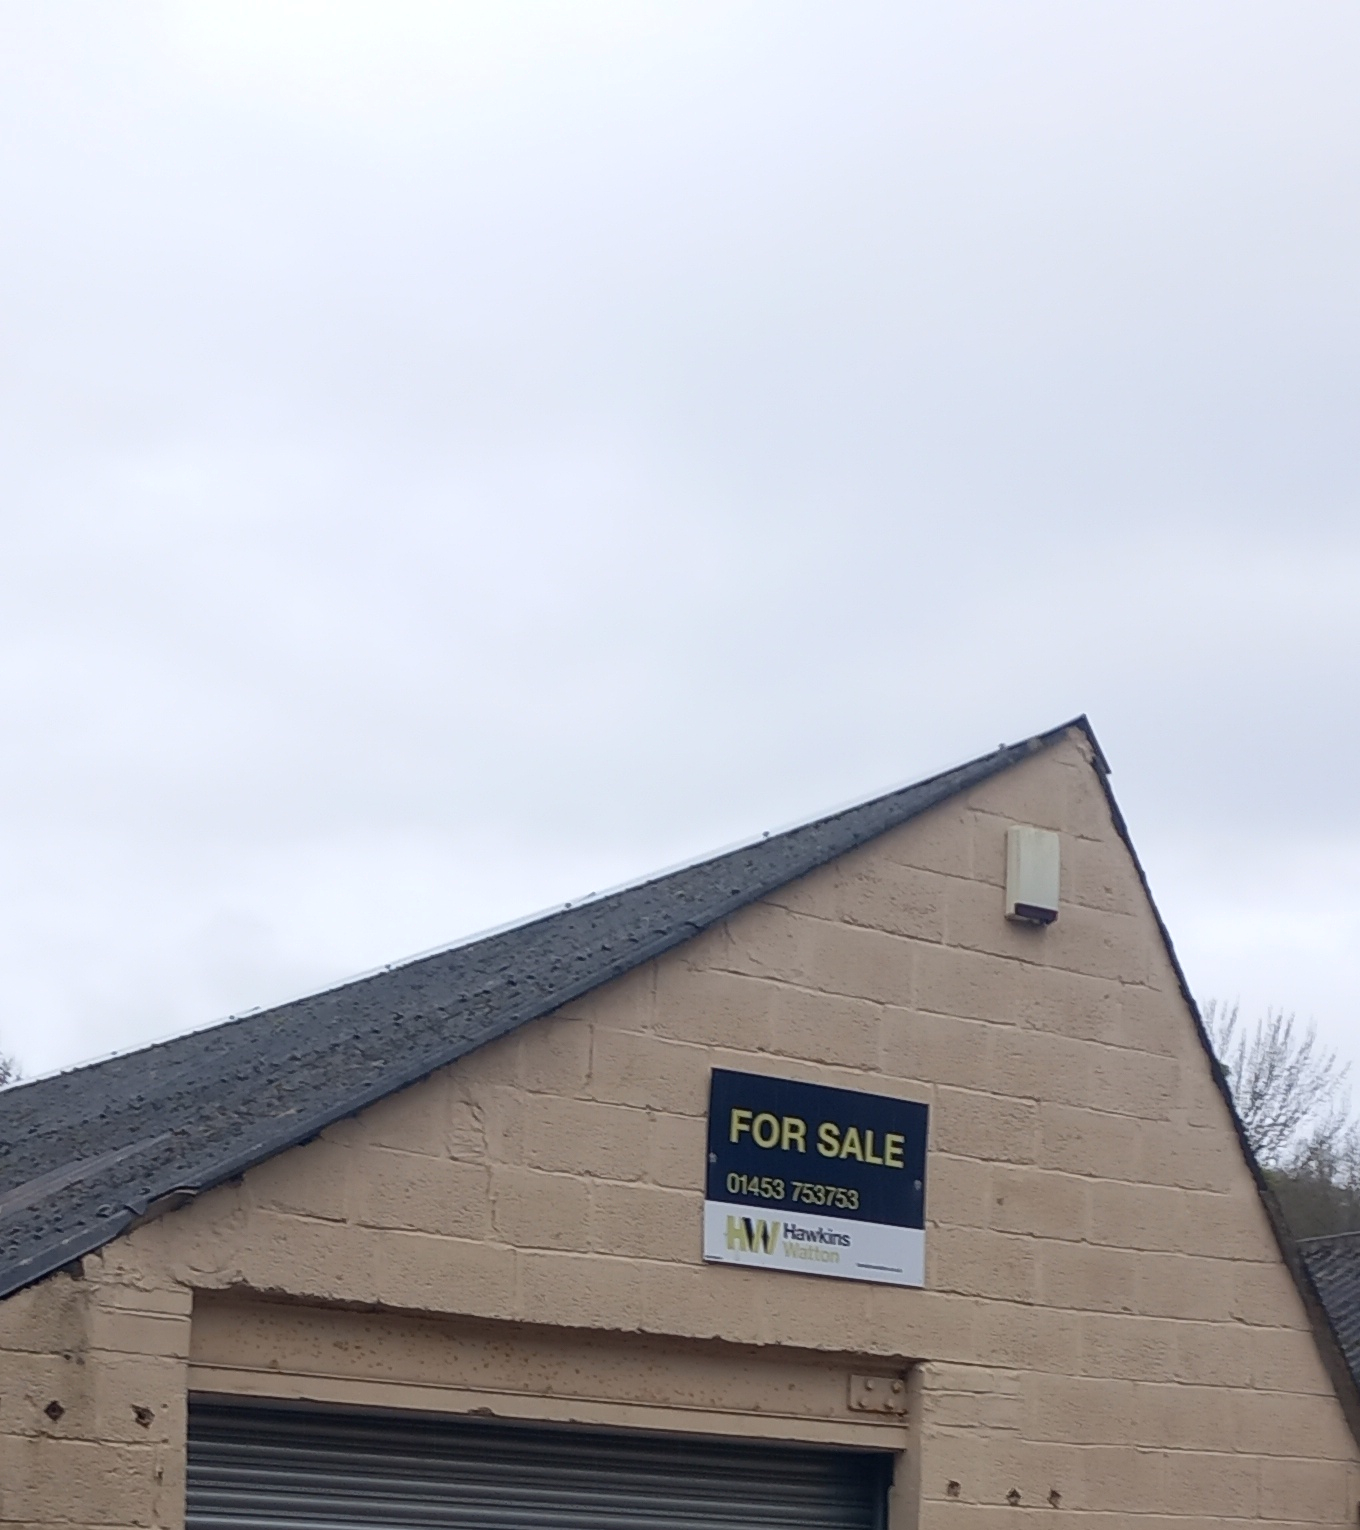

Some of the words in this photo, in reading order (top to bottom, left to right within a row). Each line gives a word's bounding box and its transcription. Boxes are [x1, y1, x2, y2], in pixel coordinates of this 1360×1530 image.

[729, 1108, 807, 1153] FOR
[816, 1122, 905, 1168] SALE
[726, 1172, 785, 1200] 01453
[791, 1181, 860, 1210] 753753
[783, 1222, 851, 1247] Hawkins
